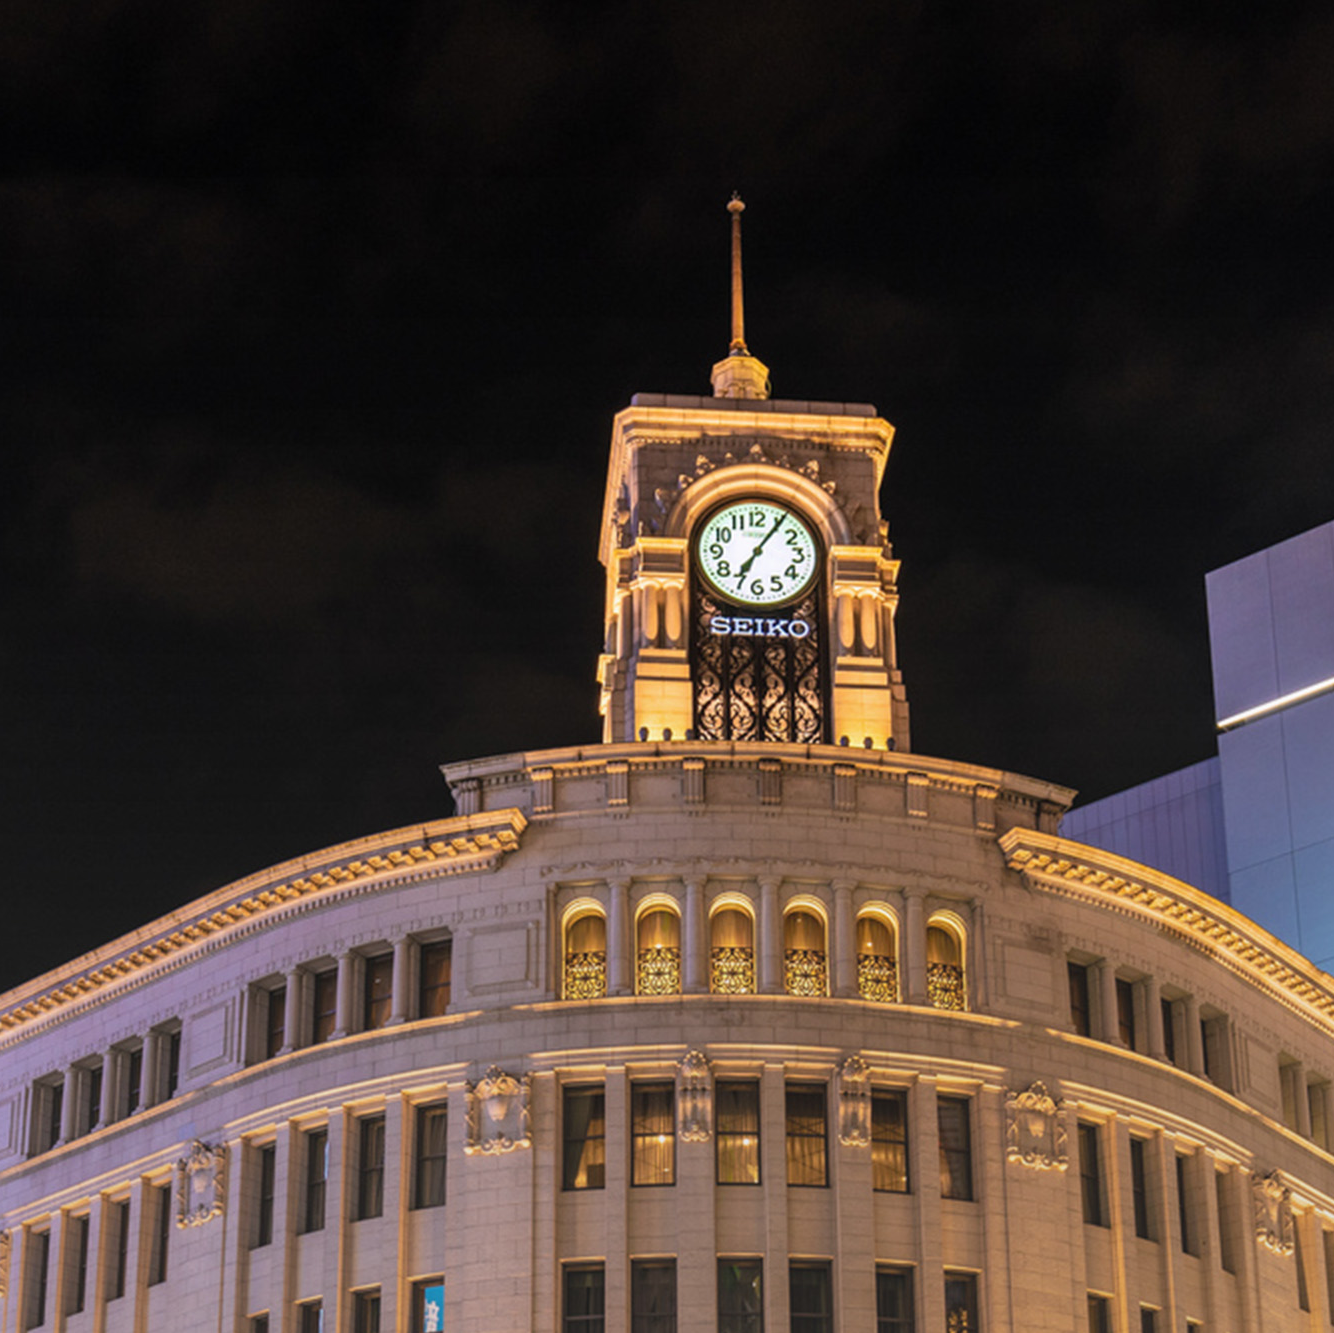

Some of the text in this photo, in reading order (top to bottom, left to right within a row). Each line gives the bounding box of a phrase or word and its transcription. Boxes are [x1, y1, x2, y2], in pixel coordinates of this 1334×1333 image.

[732, 514, 744, 530] 11
[748, 510, 766, 528] 12
[715, 526, 732, 543] 10
[785, 528, 798, 545] 2
[709, 543, 724, 559] 9
[791, 547, 805, 564] 3
[716, 560, 731, 577] 8
[784, 564, 799, 580] 4
[750, 579, 765, 596] 6
[769, 576, 783, 592] 5
[710, 615, 810, 638] SEIKO
